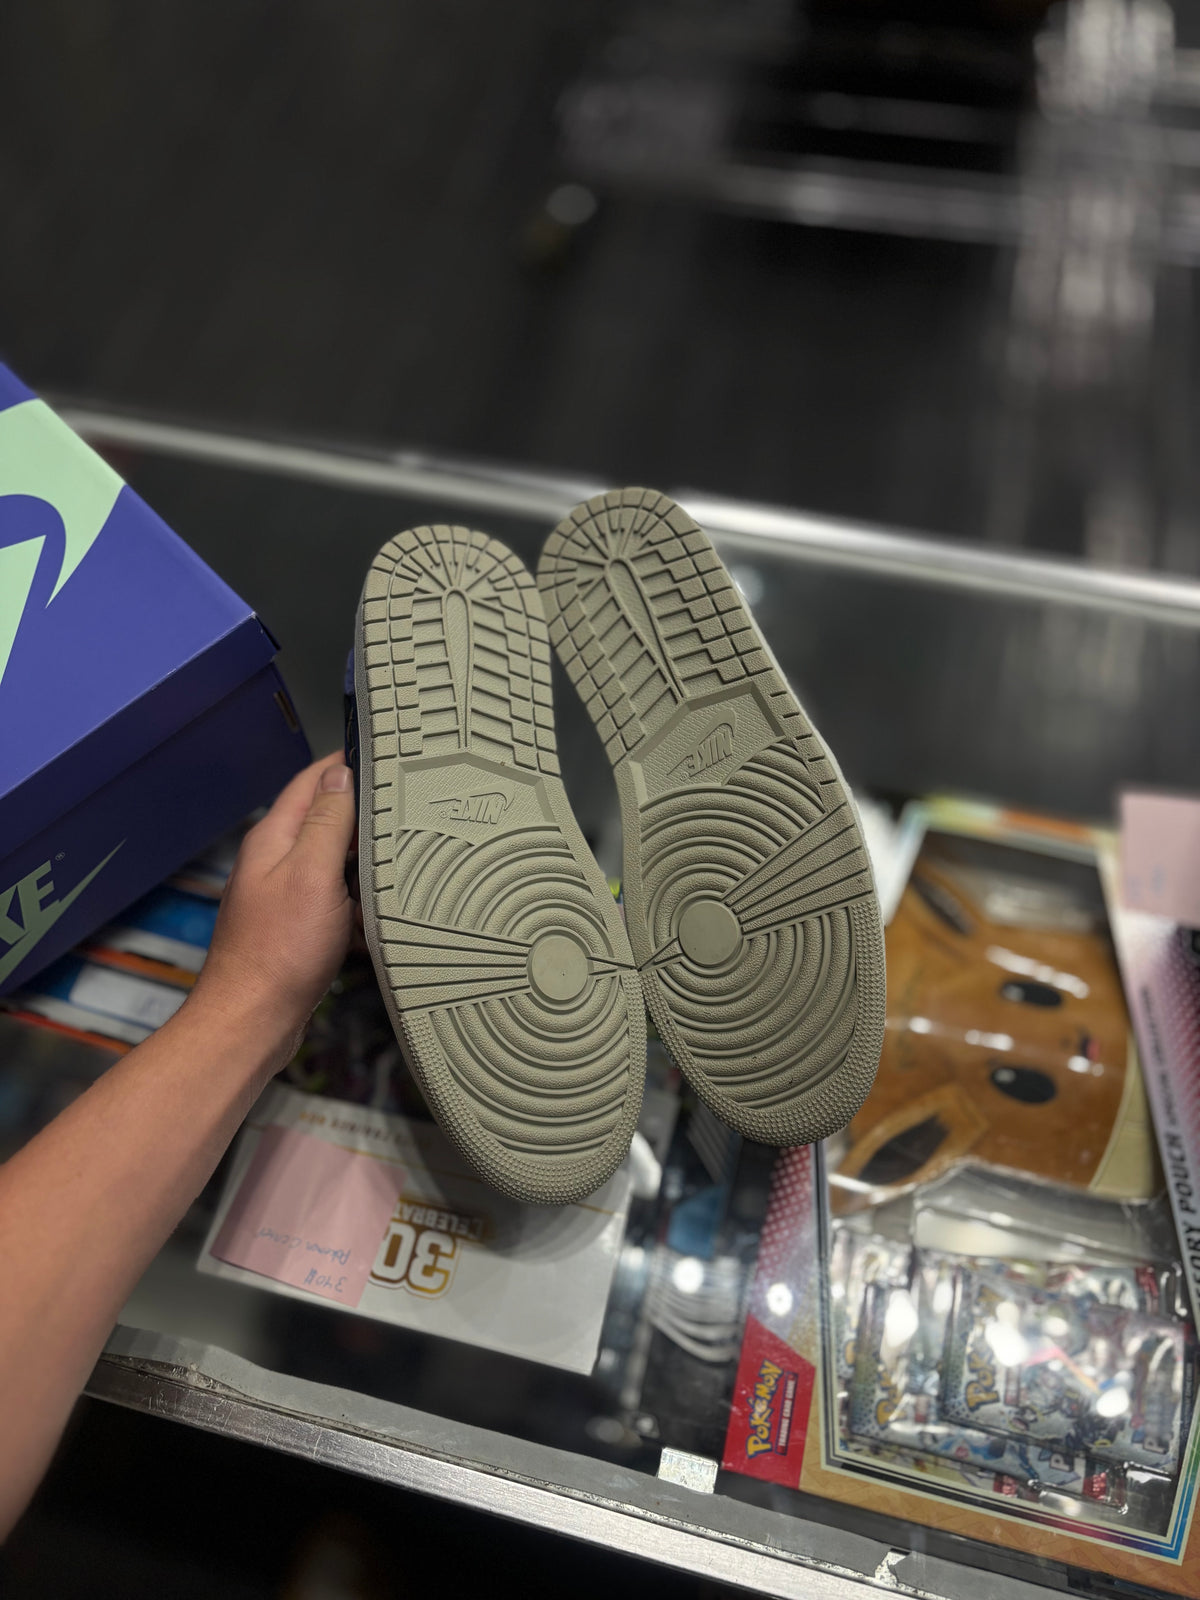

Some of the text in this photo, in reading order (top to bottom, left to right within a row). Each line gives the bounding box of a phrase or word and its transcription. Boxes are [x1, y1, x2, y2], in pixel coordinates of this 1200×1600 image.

[687, 729, 733, 777] NIKE
[449, 798, 503, 824] NIKE
[1164, 1132, 1196, 1214] POUCH
[370, 1221, 457, 1295] 30
[785, 1379, 796, 1399] GAME
[782, 1399, 792, 1417] CARD
